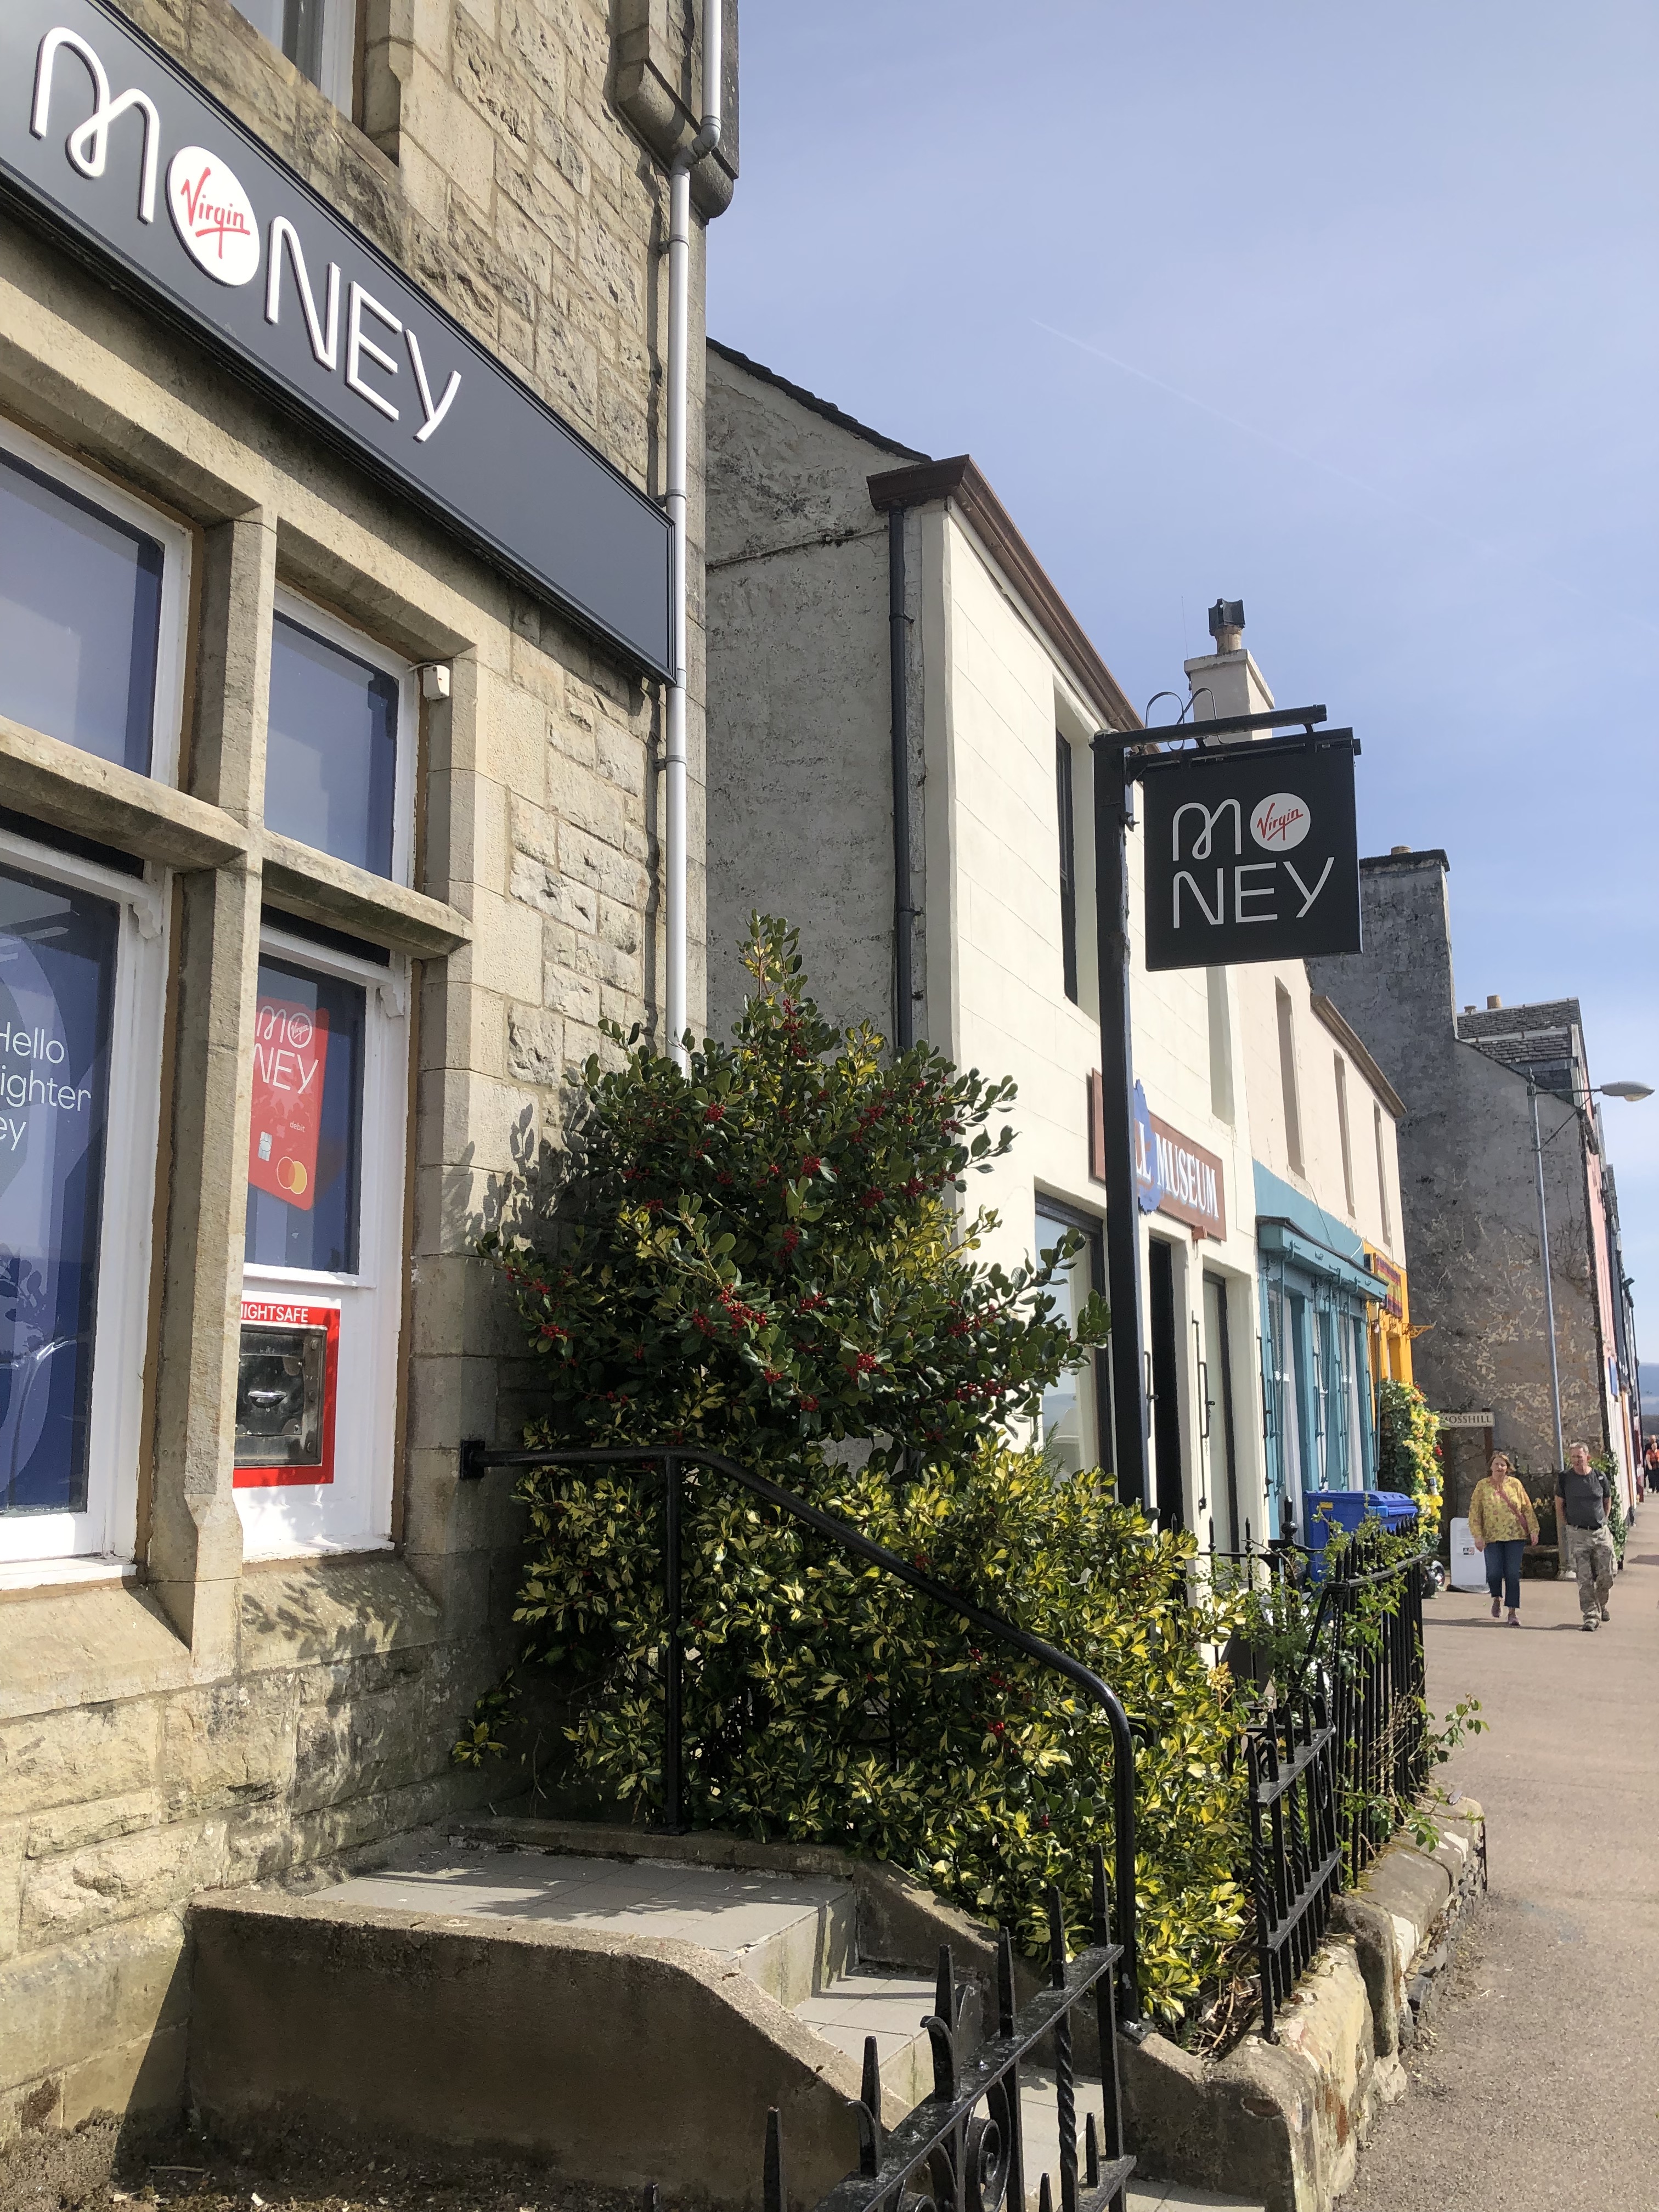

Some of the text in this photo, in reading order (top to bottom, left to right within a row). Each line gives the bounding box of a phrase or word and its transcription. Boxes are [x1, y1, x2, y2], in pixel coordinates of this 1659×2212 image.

[180, 166, 251, 259] Virgin
[1256, 802, 1304, 841] Virgin
[290, 1018, 309, 1041] Virgin
[0, 1065, 92, 1112] ighter
[289, 1120, 306, 1133] debit
[1154, 1132, 1220, 1220] MUSEUM
